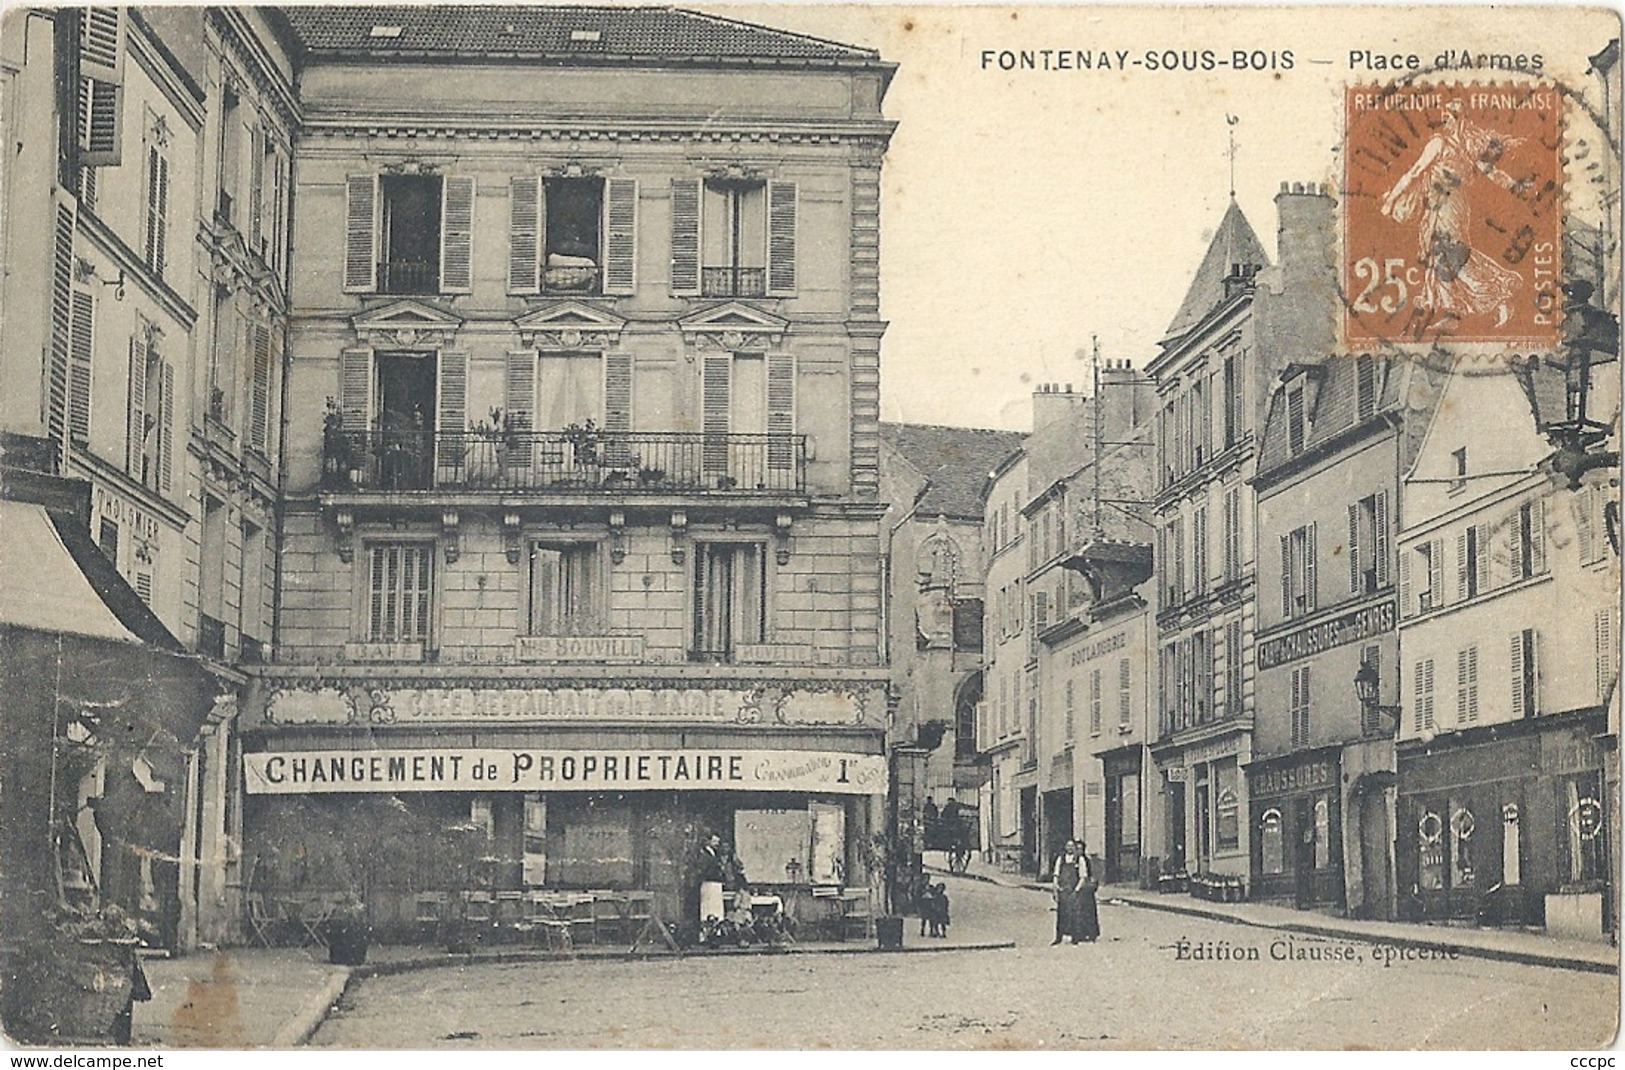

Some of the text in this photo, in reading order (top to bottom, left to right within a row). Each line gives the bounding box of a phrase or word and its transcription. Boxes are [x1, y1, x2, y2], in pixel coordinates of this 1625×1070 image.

[980, 50, 1544, 70] FONTENAY-SOUS-BOIS Place d'Armes
[1534, 241, 1553, 325] POSTES
[265, 756, 464, 784] CHANGEMENT
[471, 755, 498, 780] de
[511, 752, 743, 783] PROPRIETAIRE
